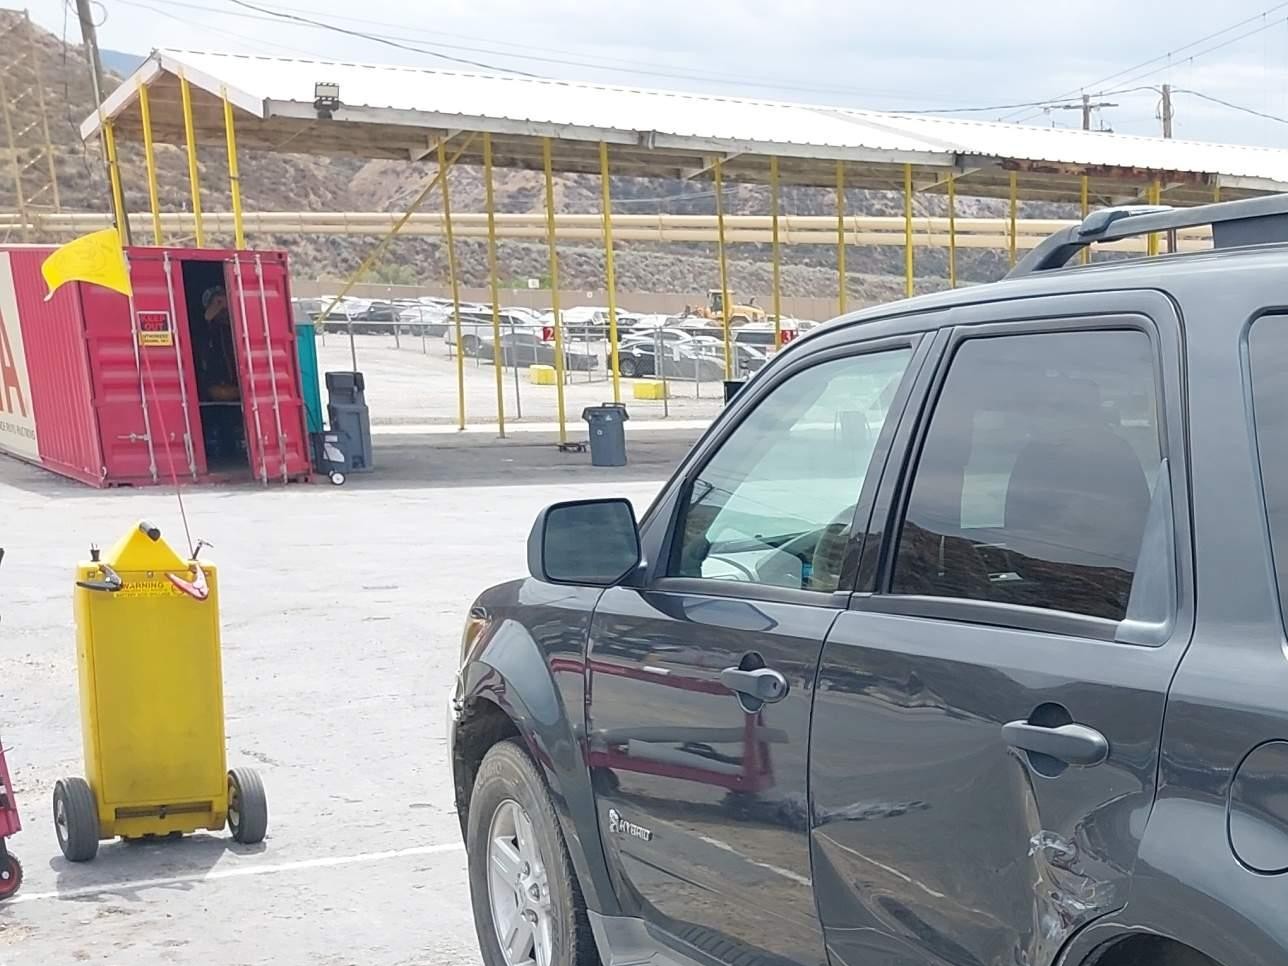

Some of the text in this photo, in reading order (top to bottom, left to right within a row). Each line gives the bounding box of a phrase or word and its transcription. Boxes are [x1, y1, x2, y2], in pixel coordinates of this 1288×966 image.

[142, 314, 165, 322] KEEP
[144, 322, 164, 330] OUT
[545, 327, 555, 340] 2
[783, 330, 792, 344] 3
[123, 581, 165, 590] WARNING
[619, 819, 651, 841] HYBRID
